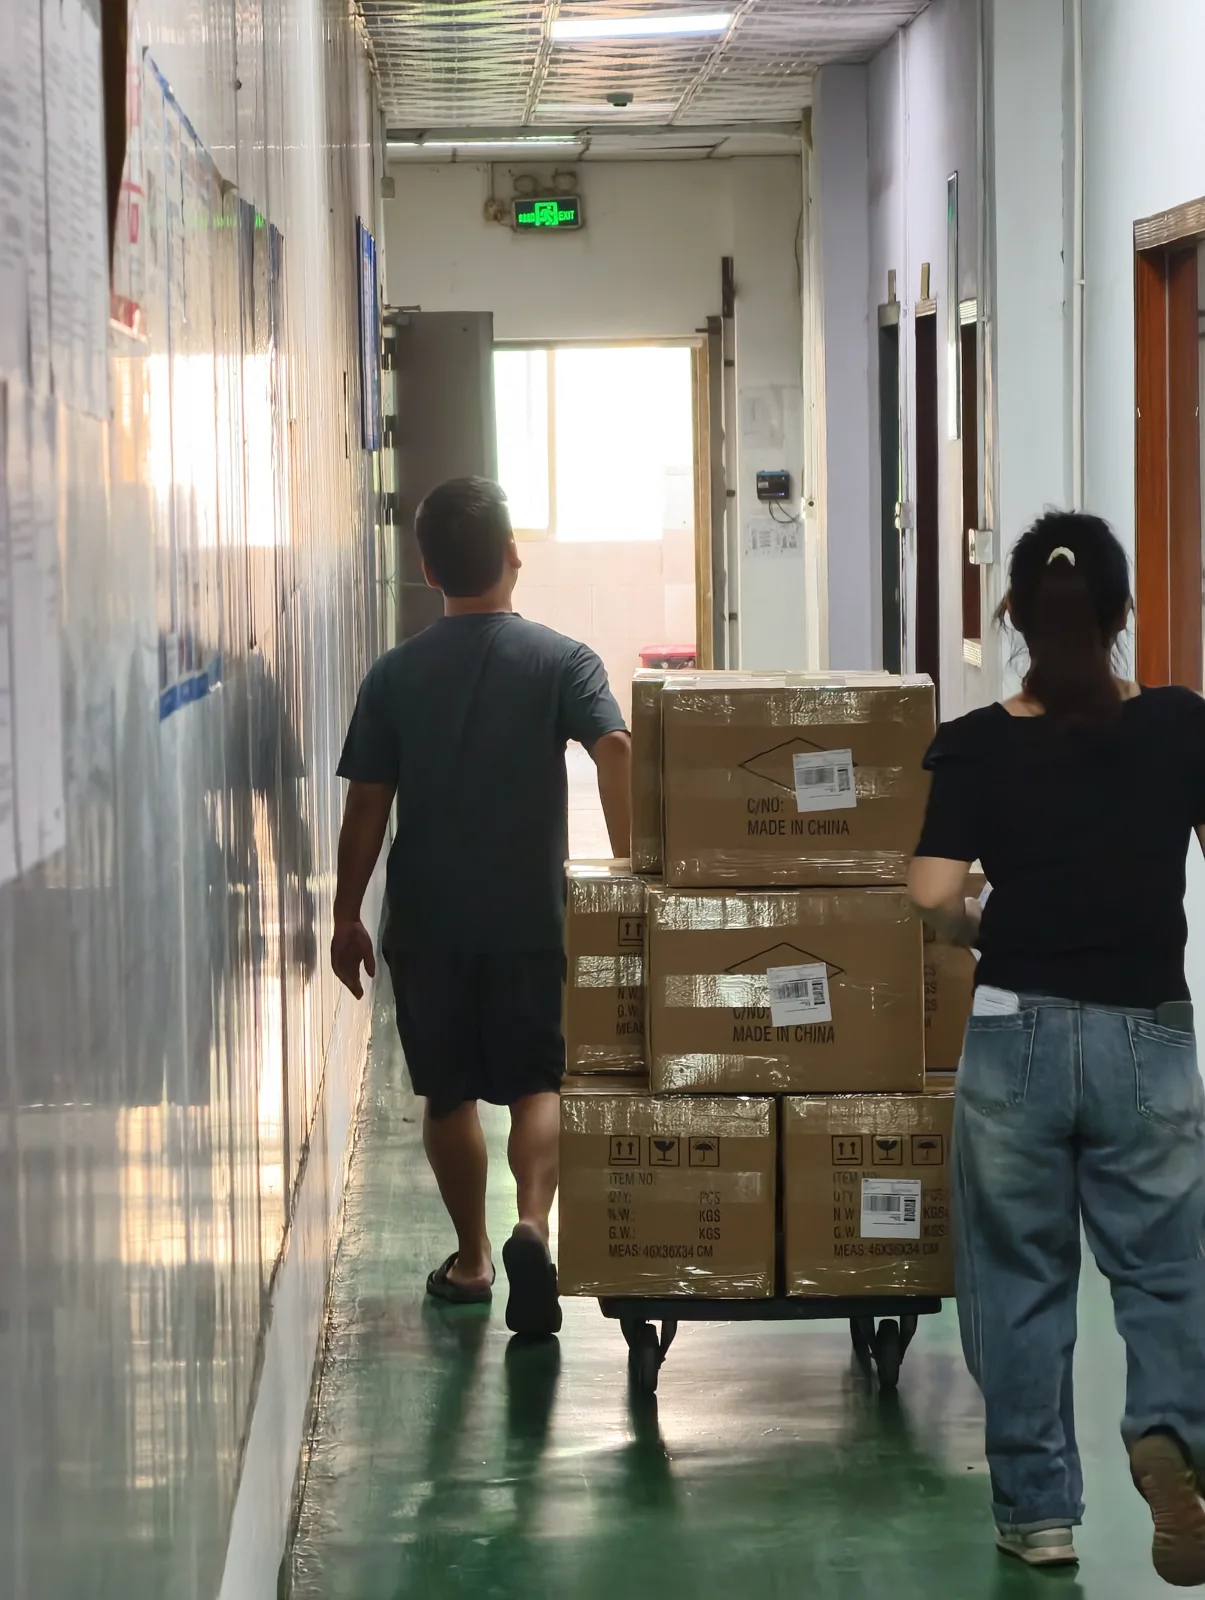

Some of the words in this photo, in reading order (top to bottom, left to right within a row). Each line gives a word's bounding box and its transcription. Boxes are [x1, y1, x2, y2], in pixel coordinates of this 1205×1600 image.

[558, 210, 575, 221] EXIT
[747, 796, 784, 815] C/NO:
[747, 819, 786, 836] MADE
[791, 819, 804, 836] IN
[807, 819, 850, 836] CHINA
[732, 1026, 772, 1042] MADE
[776, 1026, 790, 1043] IN
[794, 1026, 835, 1045] CHINA
[609, 1172, 634, 1186] ITEM
[833, 1171, 858, 1185] ITEM
[699, 1190, 721, 1205] PCS
[699, 1208, 721, 1222] KGS
[699, 1226, 721, 1240] KGS
[643, 1244, 694, 1259] 46X36X34
[696, 1244, 713, 1258] CM
